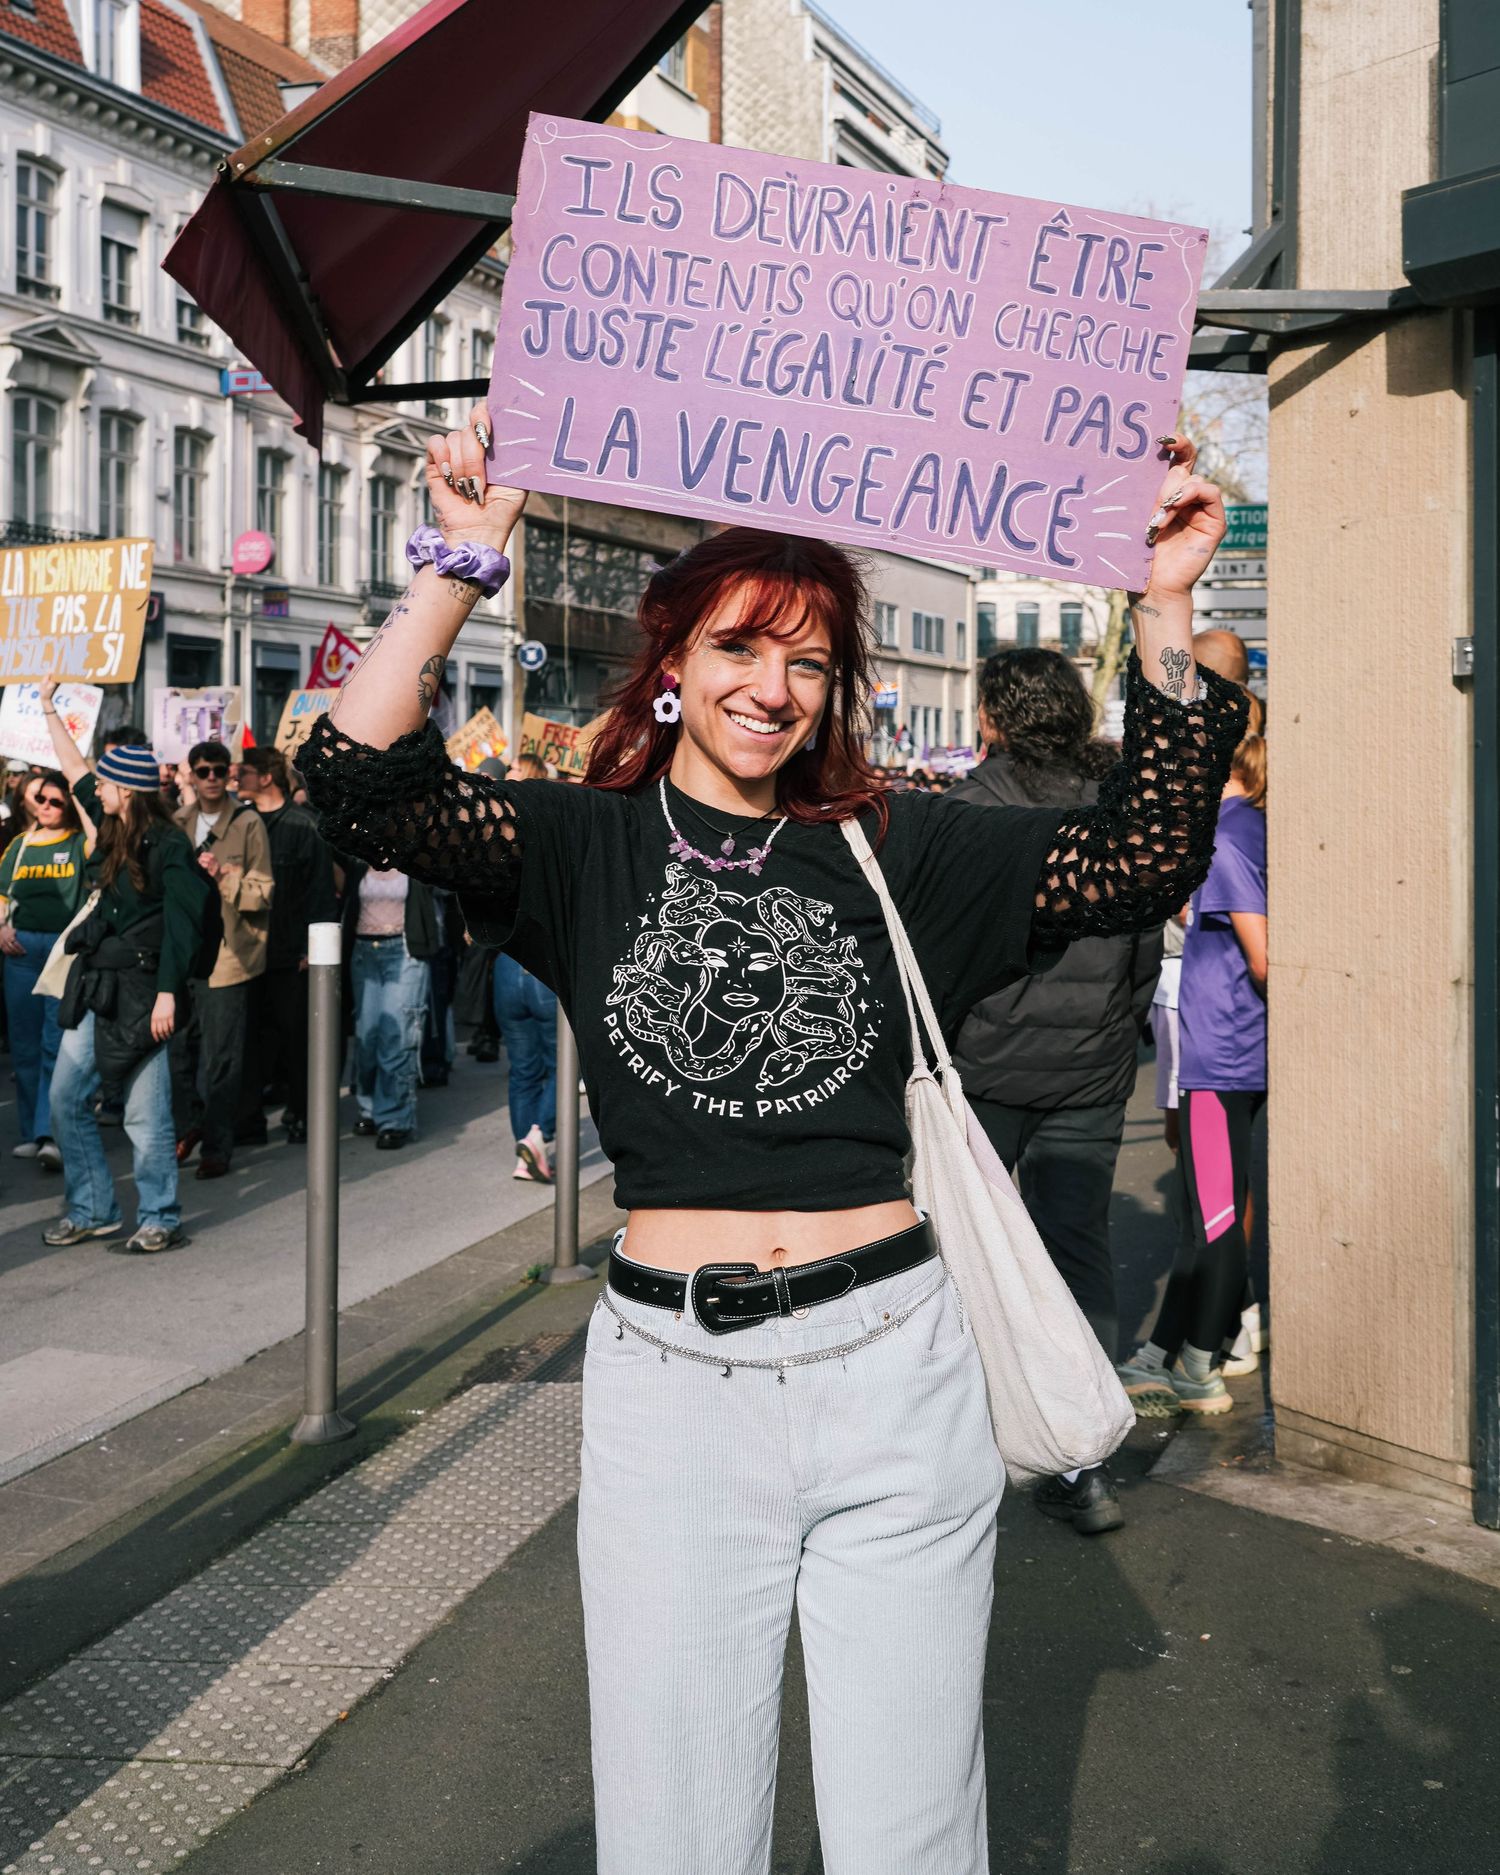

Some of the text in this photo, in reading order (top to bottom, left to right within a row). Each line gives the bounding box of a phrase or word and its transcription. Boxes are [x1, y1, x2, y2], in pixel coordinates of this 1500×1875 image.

[562, 154, 1166, 312] ILS DEVRAIENT ÊTRE
[541, 232, 1177, 383] CONTENTS QU'ON CHERCHE
[522, 300, 1151, 461] JUSTE L'ÉGALITÉ ET PAS
[551, 395, 641, 480] LA
[1, 542, 149, 596] LA MISANDRIE NE
[1211, 563, 1247, 575] AINT
[6, 596, 43, 637] TUE
[51, 594, 88, 634] PAS.
[94, 593, 121, 632] LA
[96, 632, 125, 677] SI
[542, 723, 581, 750] FREE
[603, 1012, 879, 1118] PETRIFY THE PATRIARCHY
